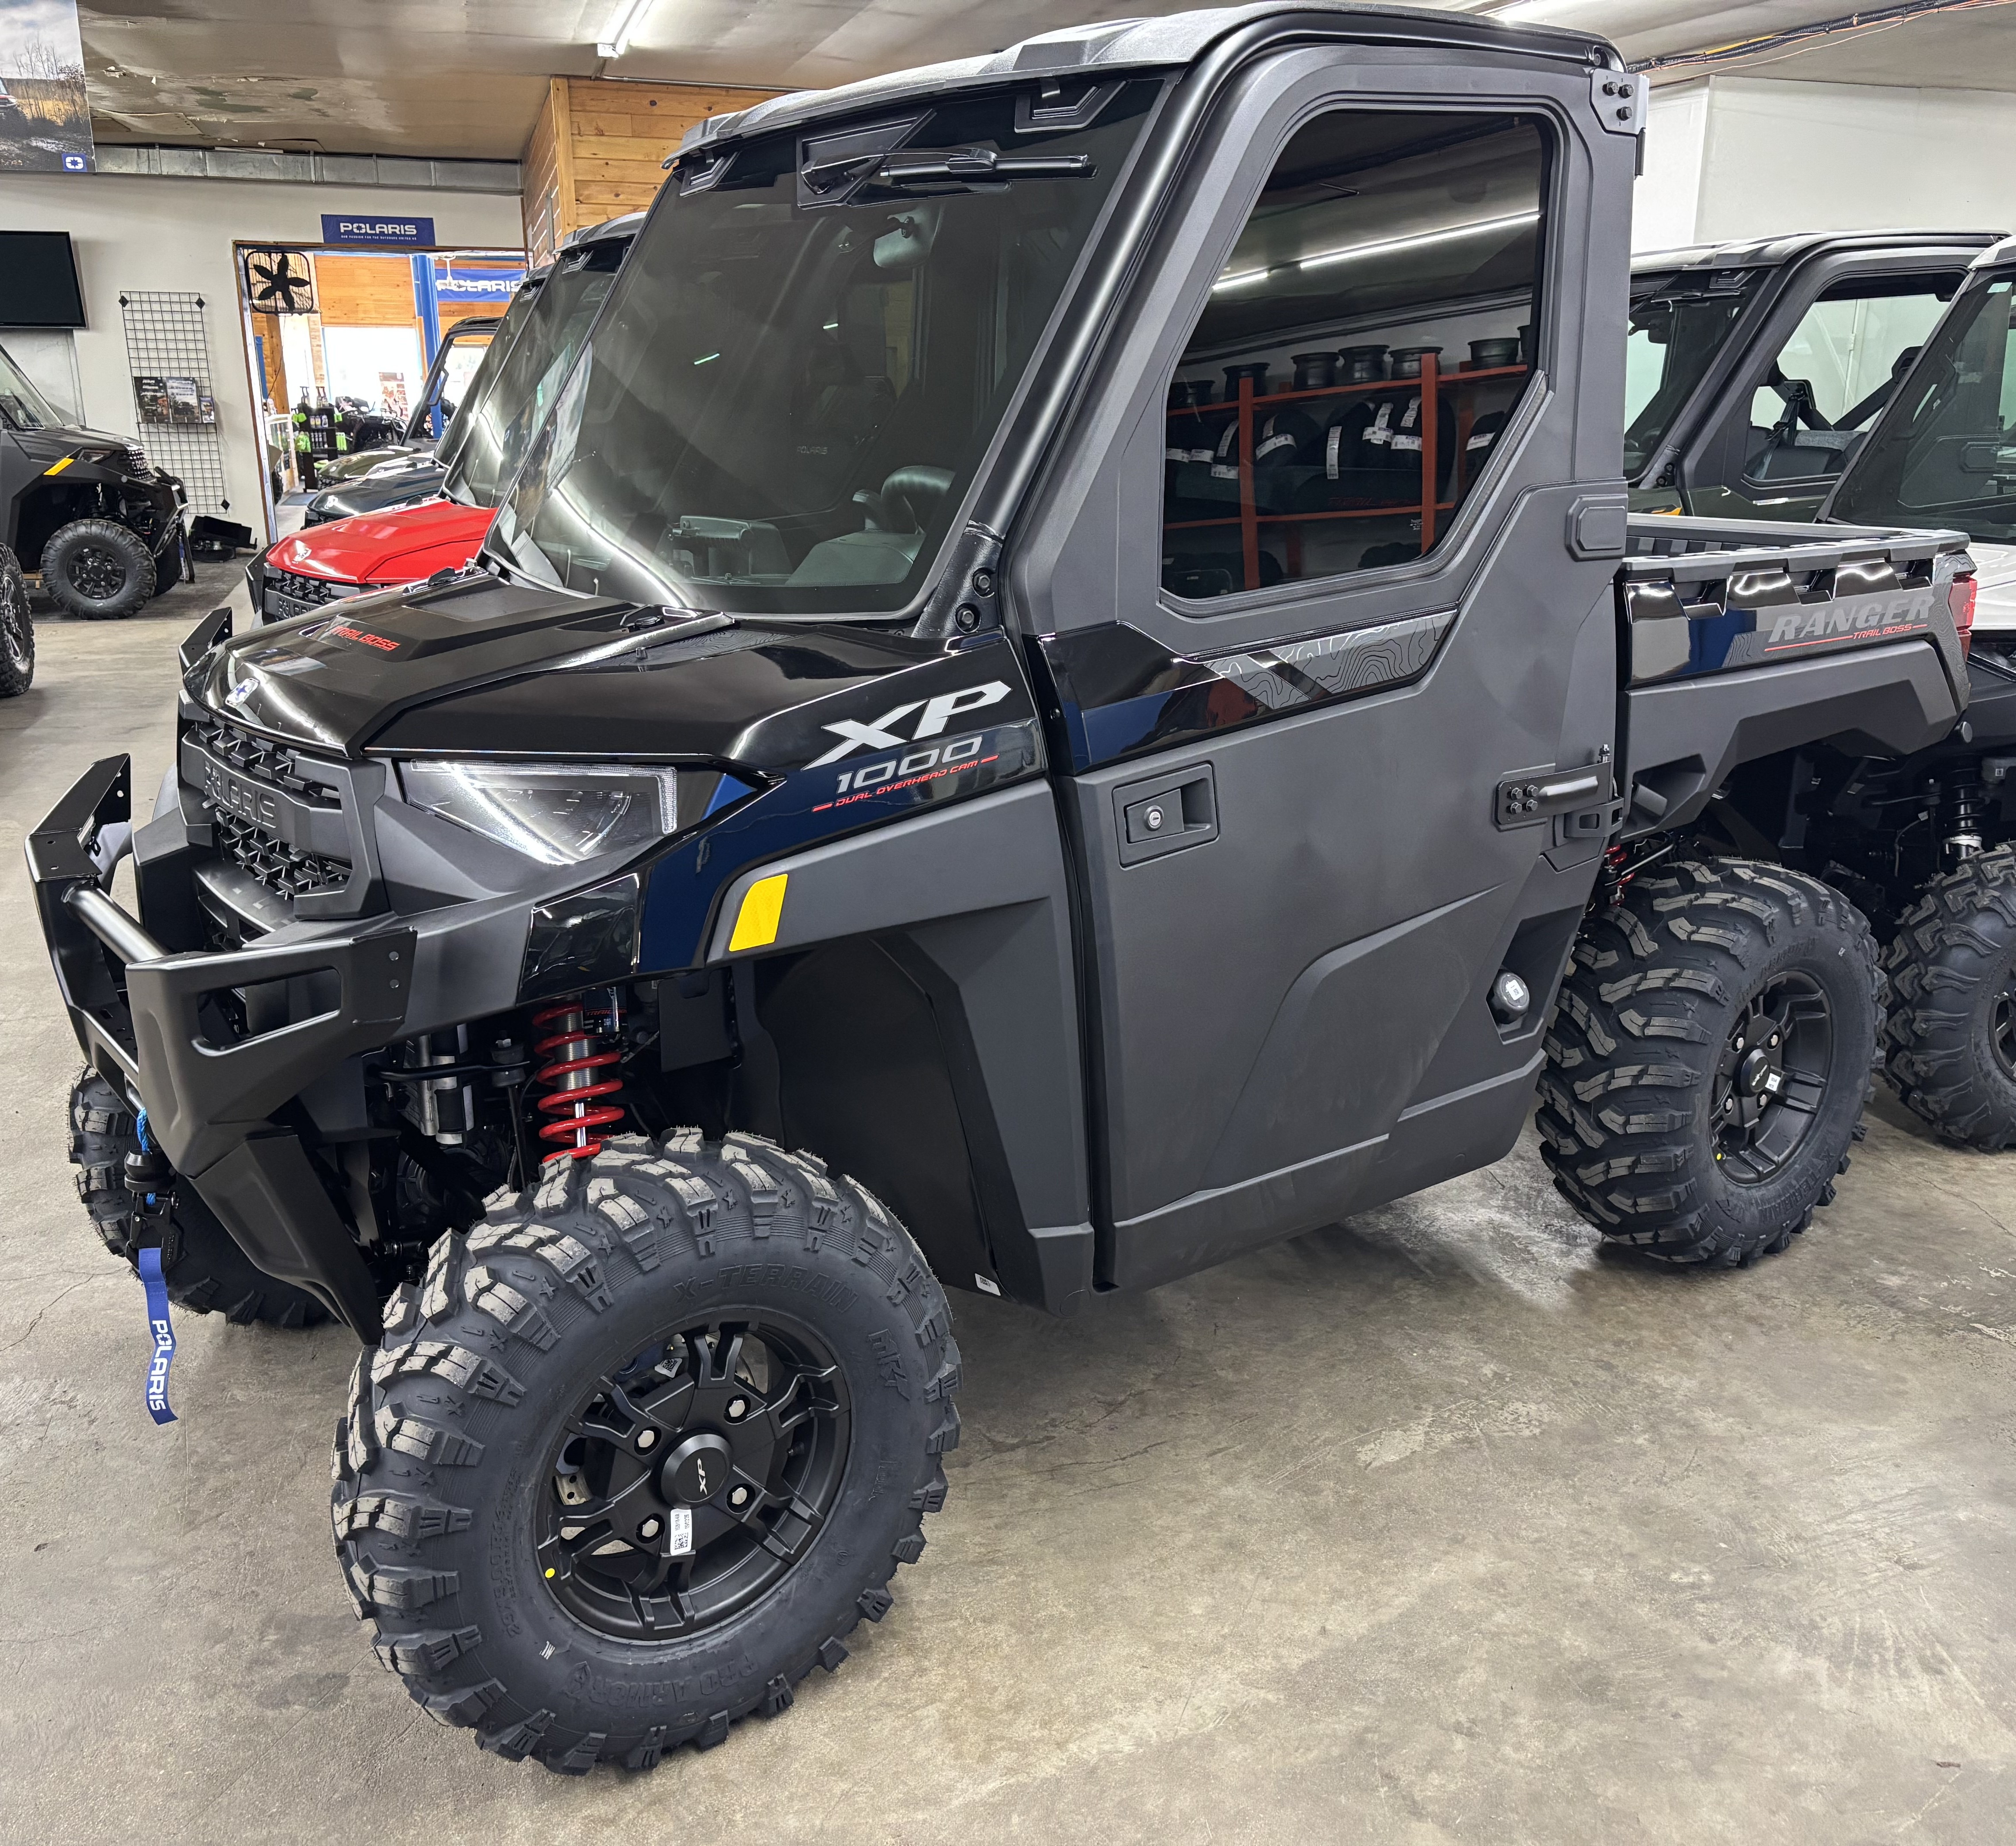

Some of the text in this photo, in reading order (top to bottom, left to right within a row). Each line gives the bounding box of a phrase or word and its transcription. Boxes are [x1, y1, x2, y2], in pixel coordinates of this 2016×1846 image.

[340, 222, 417, 235] POLARIS
[1768, 595, 1935, 642] RANGER
[1853, 624, 1912, 639] TRAIL BOSS
[359, 634, 401, 651] BOSS
[801, 680, 1012, 771] XP
[835, 760, 979, 807] DUAL OVERHEAD CAM
[837, 735, 983, 794] 1000
[205, 761, 277, 828] POLARIS
[673, 1263, 859, 1313] X-TERRAIN
[149, 1319, 172, 1412] POLARIS
[697, 1458, 707, 1495] XP
